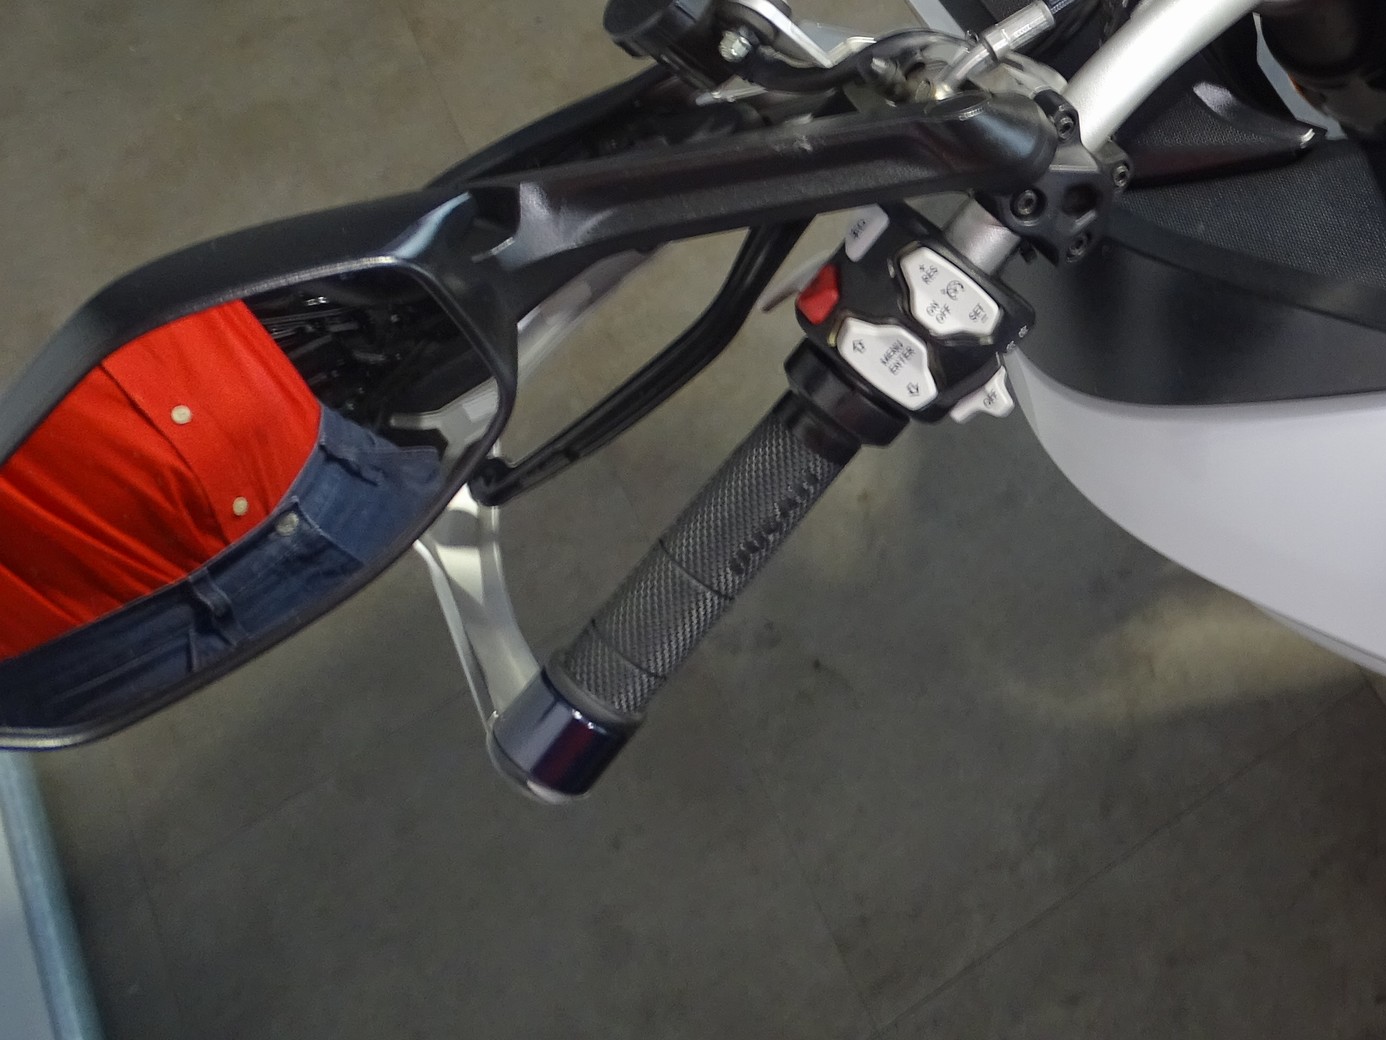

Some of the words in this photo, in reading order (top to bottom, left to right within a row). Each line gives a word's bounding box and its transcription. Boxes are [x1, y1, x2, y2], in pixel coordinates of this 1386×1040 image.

[969, 303, 985, 321] SET
[880, 339, 904, 366] MENU
[889, 345, 916, 375] ENTER
